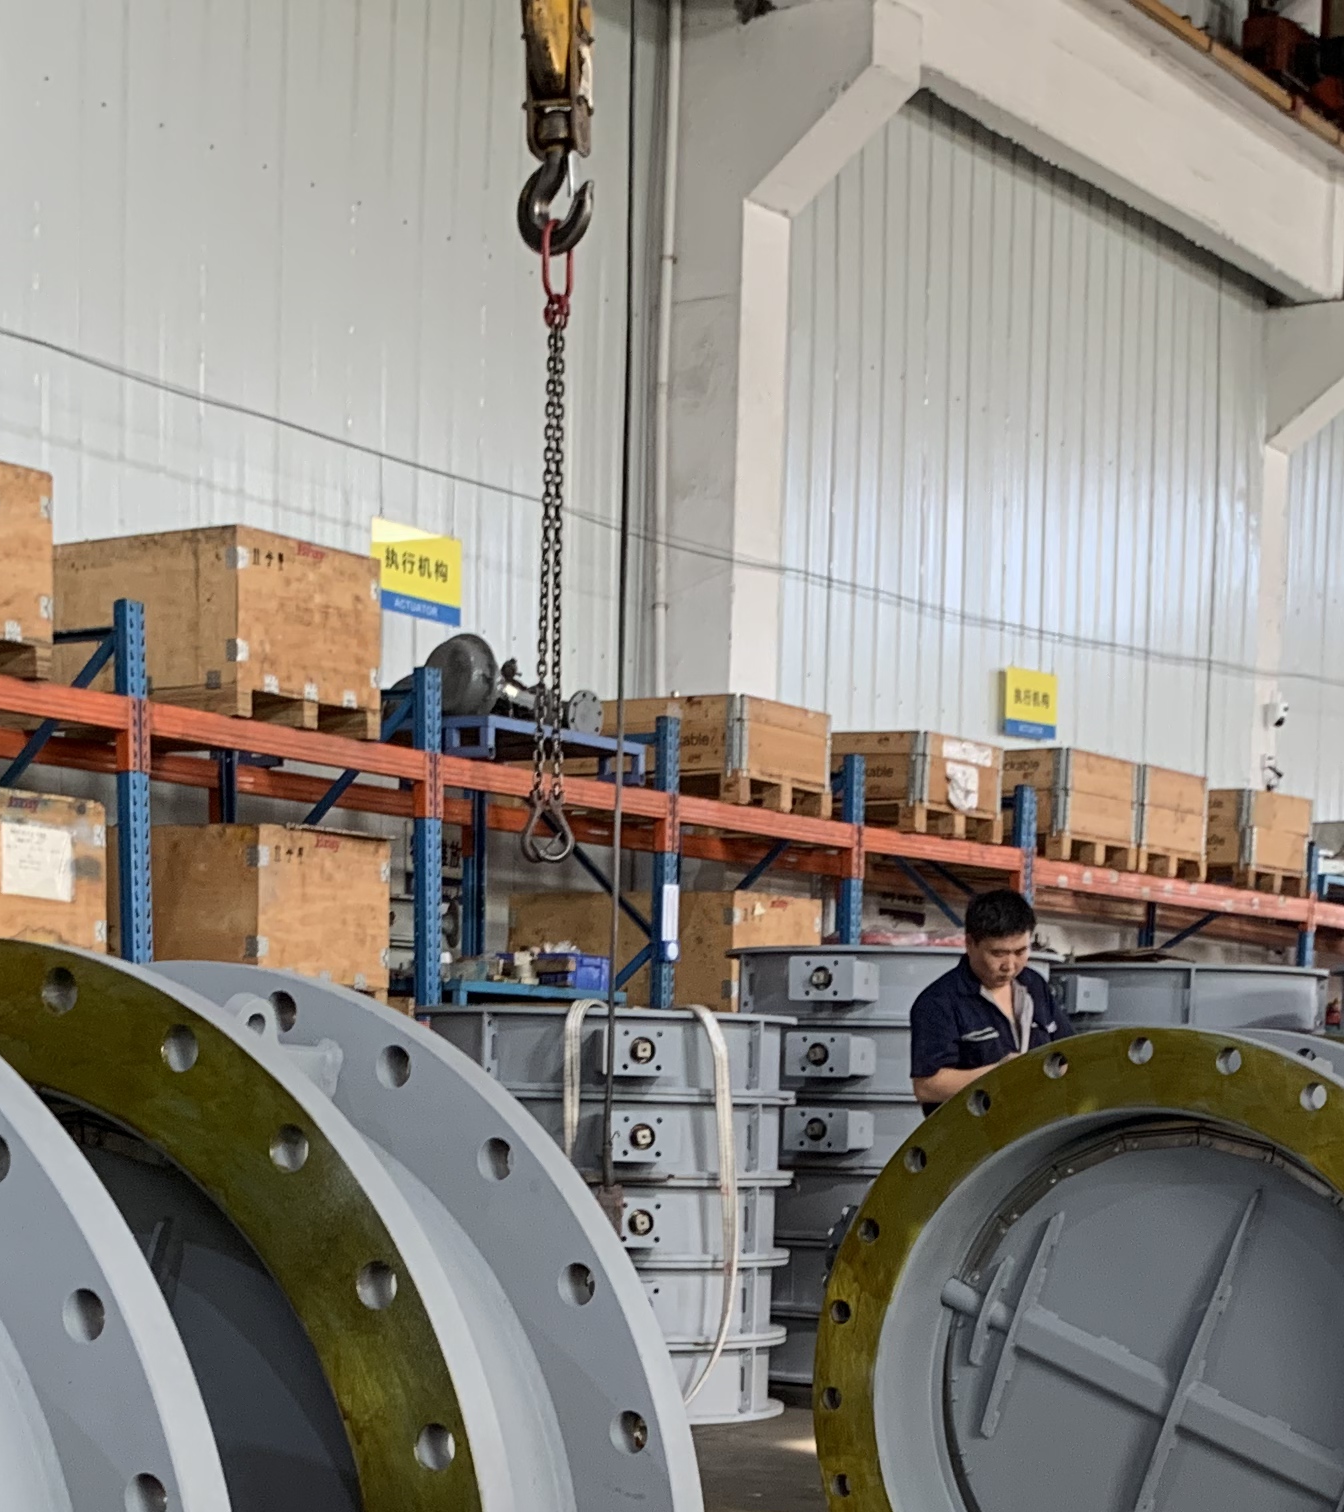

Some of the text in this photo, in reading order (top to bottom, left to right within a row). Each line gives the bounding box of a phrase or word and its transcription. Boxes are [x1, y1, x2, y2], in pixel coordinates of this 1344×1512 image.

[385, 546, 449, 583] 执行机构
[394, 597, 439, 616] ACTUATOR
